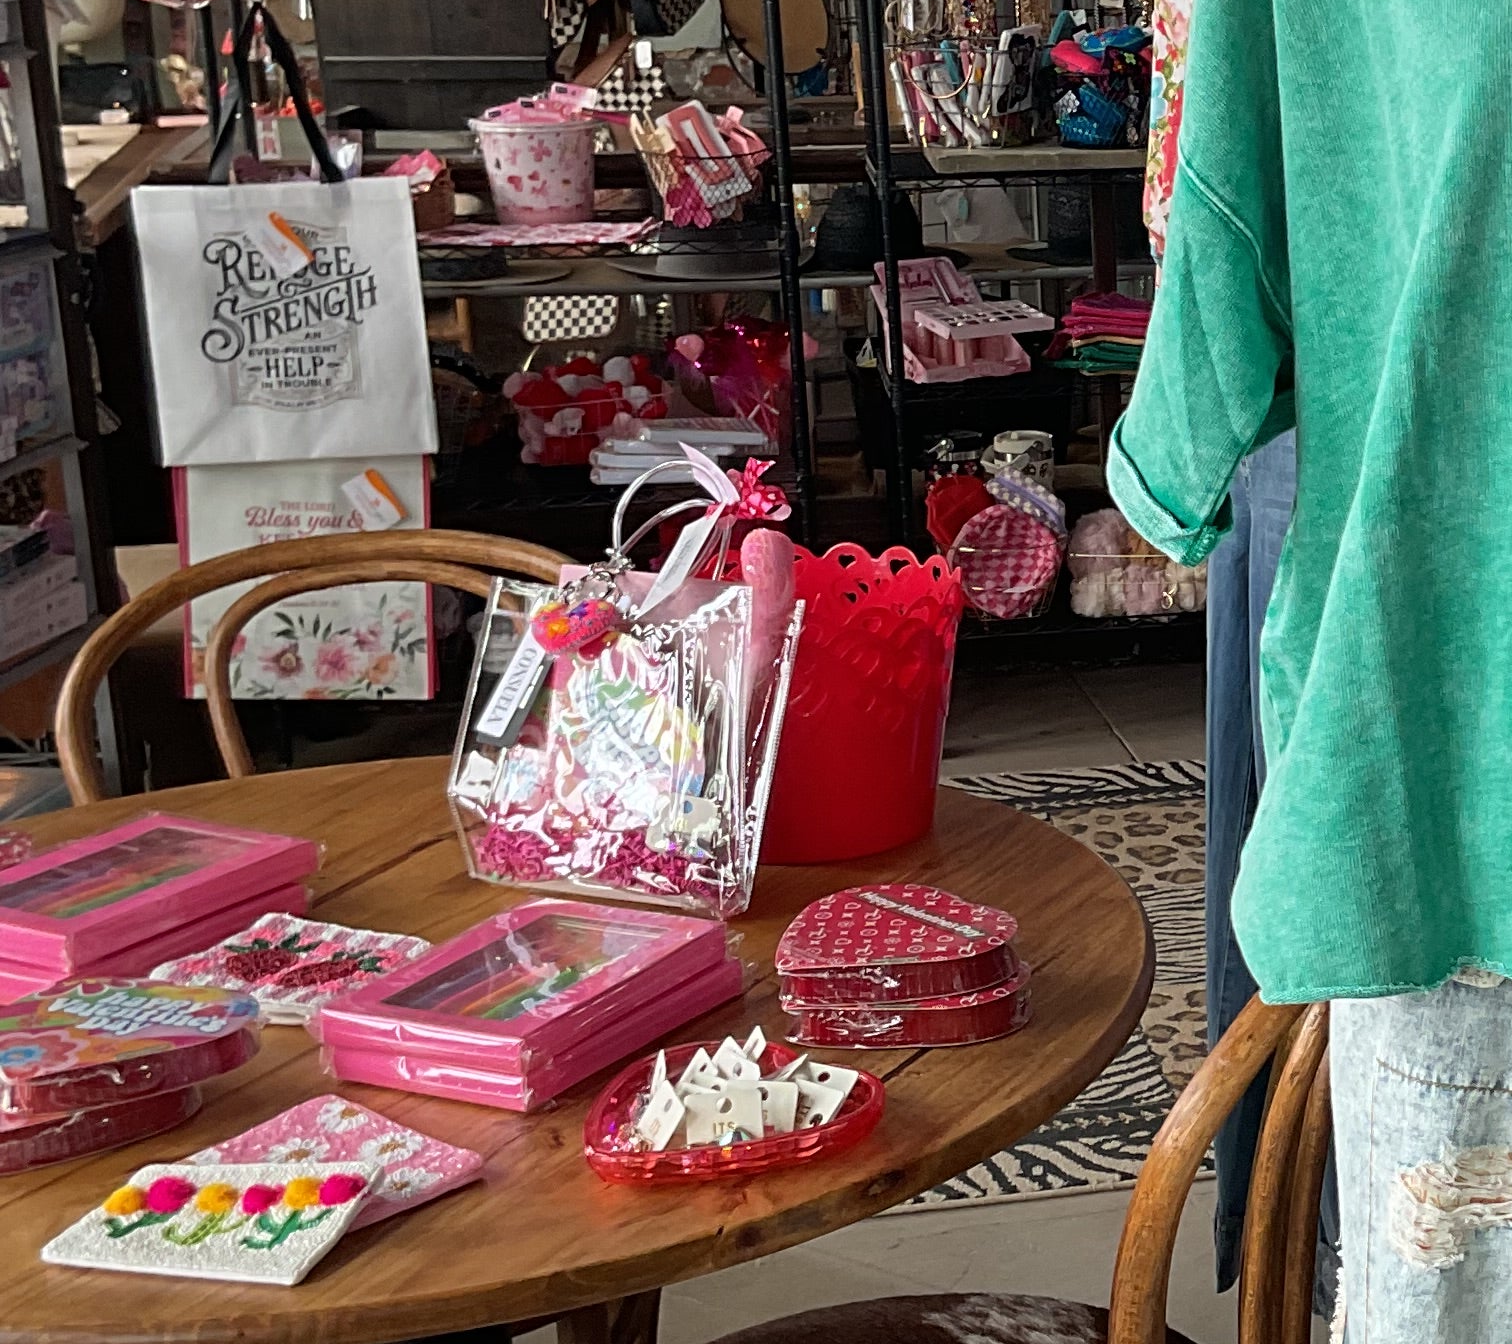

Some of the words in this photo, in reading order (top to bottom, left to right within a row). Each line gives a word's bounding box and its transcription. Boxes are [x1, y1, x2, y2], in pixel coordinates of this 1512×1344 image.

[203, 238, 357, 299] REGE
[201, 274, 379, 363] STRENGTH
[304, 332, 322, 340] AN
[248, 344, 338, 356] EVER-PRESENT
[265, 356, 324, 378] HELP
[261, 380, 273, 389] IN
[278, 378, 332, 389] TROUBLE
[245, 506, 301, 528] Bless
[307, 512, 343, 534] you
[487, 647, 538, 723] CONSUELA
